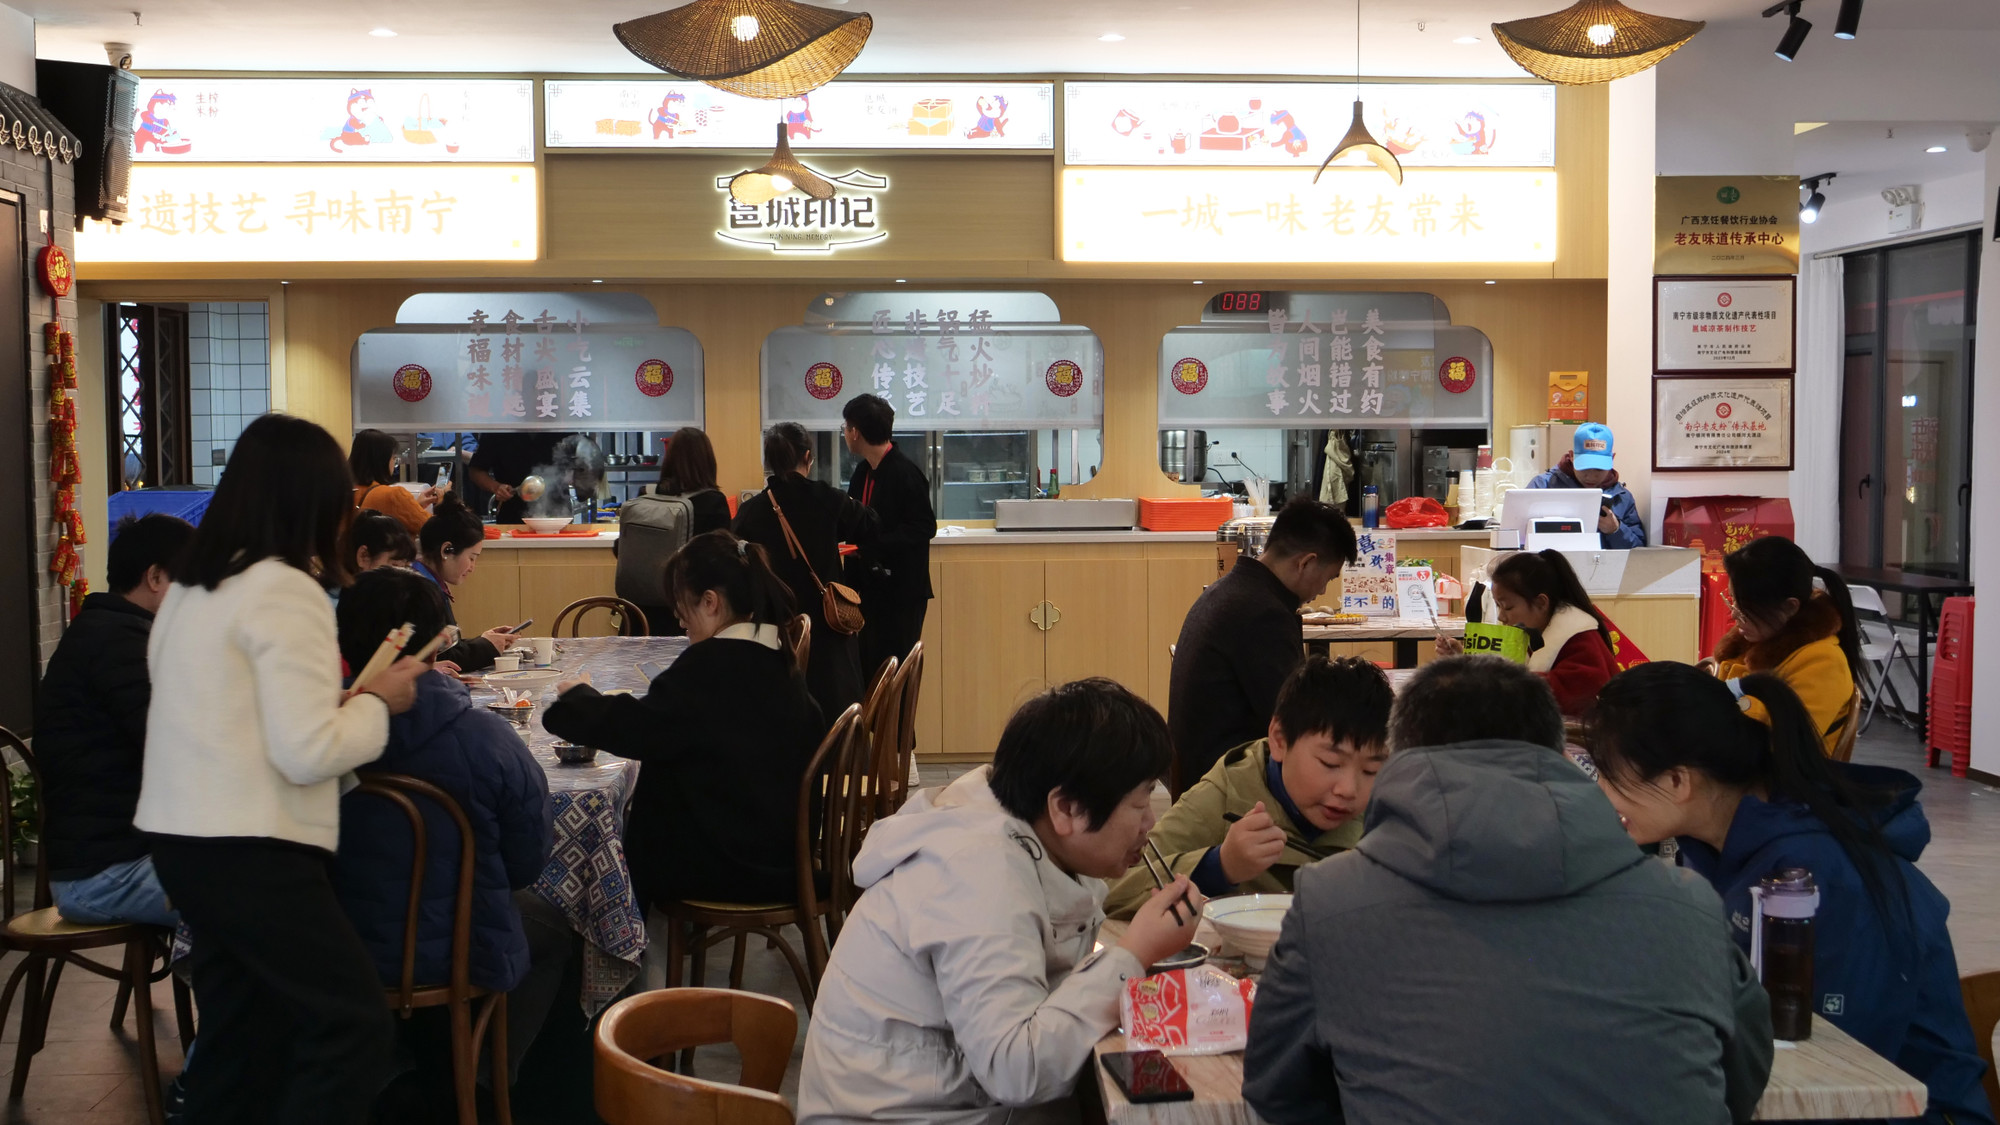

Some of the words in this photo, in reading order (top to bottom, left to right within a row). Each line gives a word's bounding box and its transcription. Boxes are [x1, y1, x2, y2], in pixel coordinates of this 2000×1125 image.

[104, 189, 269, 235] 遗技艺
[284, 189, 458, 235] 寻味南宁
[1141, 193, 1309, 237] 一城一味
[1321, 192, 1484, 237] 老友常来
[1681, 215, 1778, 225] 广西烹饪餐饮行业协会
[1674, 231, 1784, 246] 老友味道传承中心
[1222, 293, 1261, 311] 088
[1298, 309, 1322, 415] 人间烟火
[1329, 309, 1353, 415] 岂能错过
[1360, 309, 1385, 415] 美食有约
[1384, 552, 1395, 575] 集章
